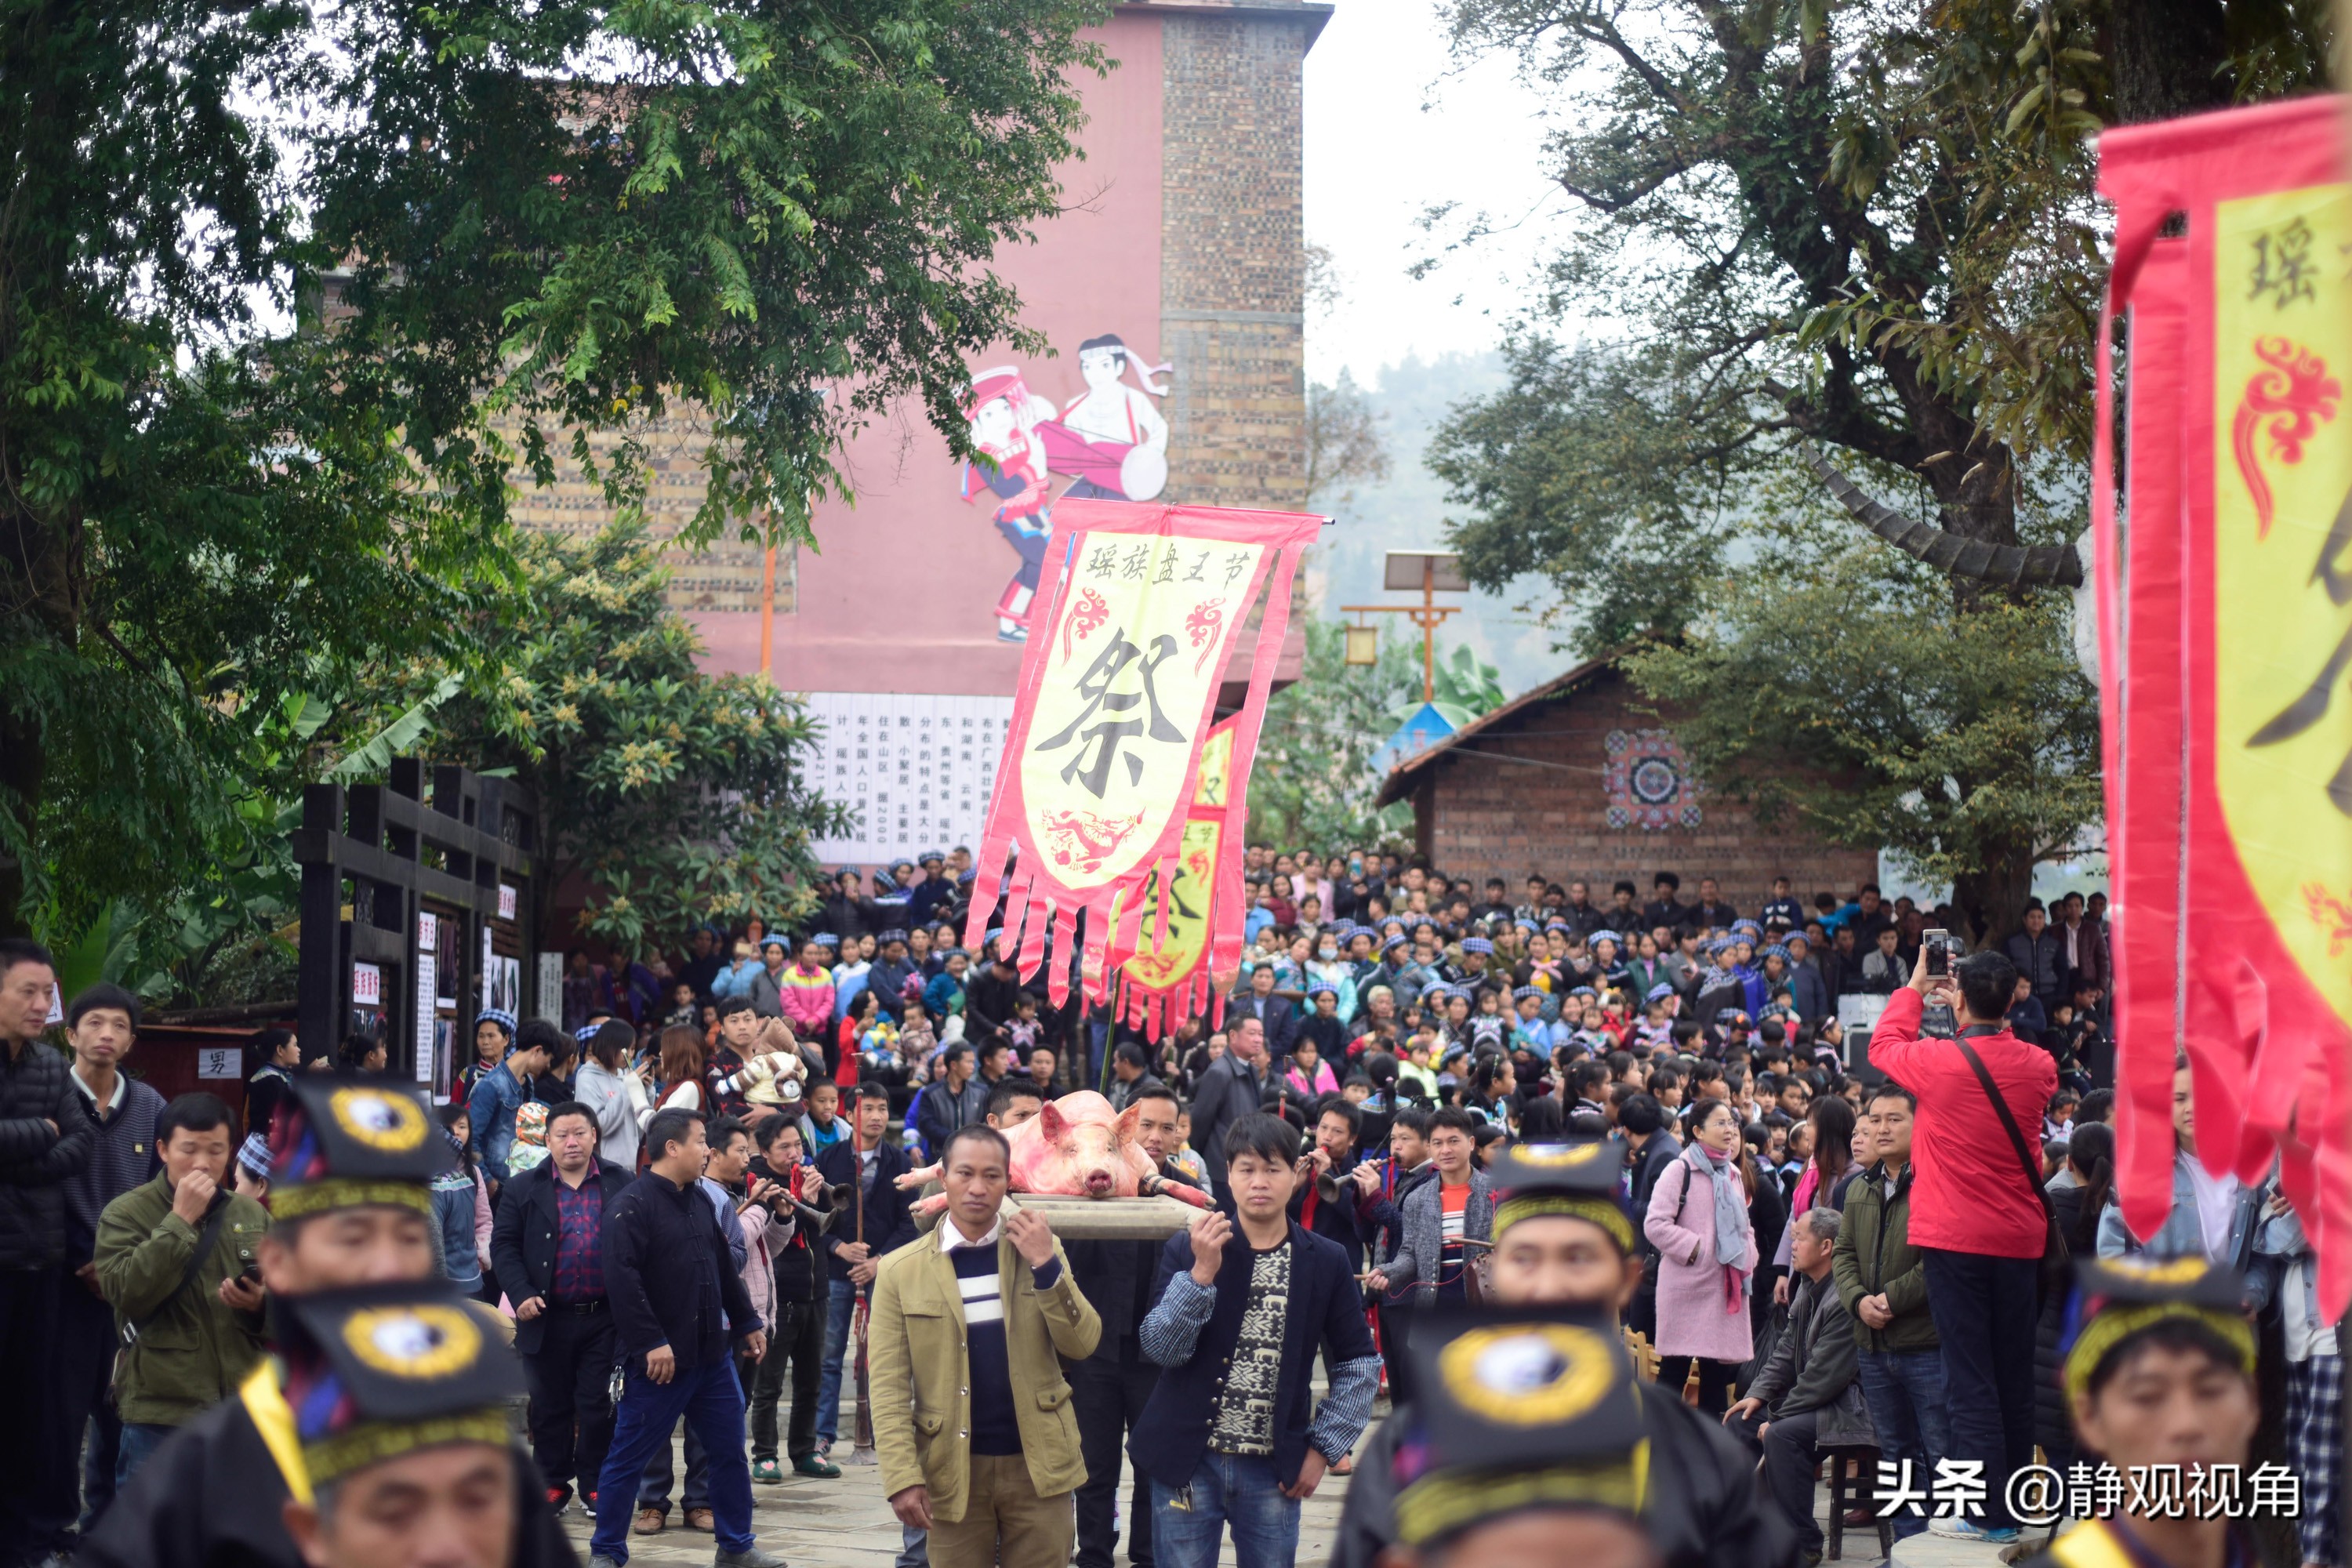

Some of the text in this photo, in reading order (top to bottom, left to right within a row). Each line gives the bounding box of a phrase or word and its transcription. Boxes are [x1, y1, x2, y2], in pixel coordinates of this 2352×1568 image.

[1086, 543, 1250, 590] 瑶族盘王节
[1035, 626, 1188, 800] 祭
[918, 717, 931, 844] 分布的特点是大分
[982, 718, 993, 844] 布在广西壮族自
[210, 1051, 225, 1074] 男
